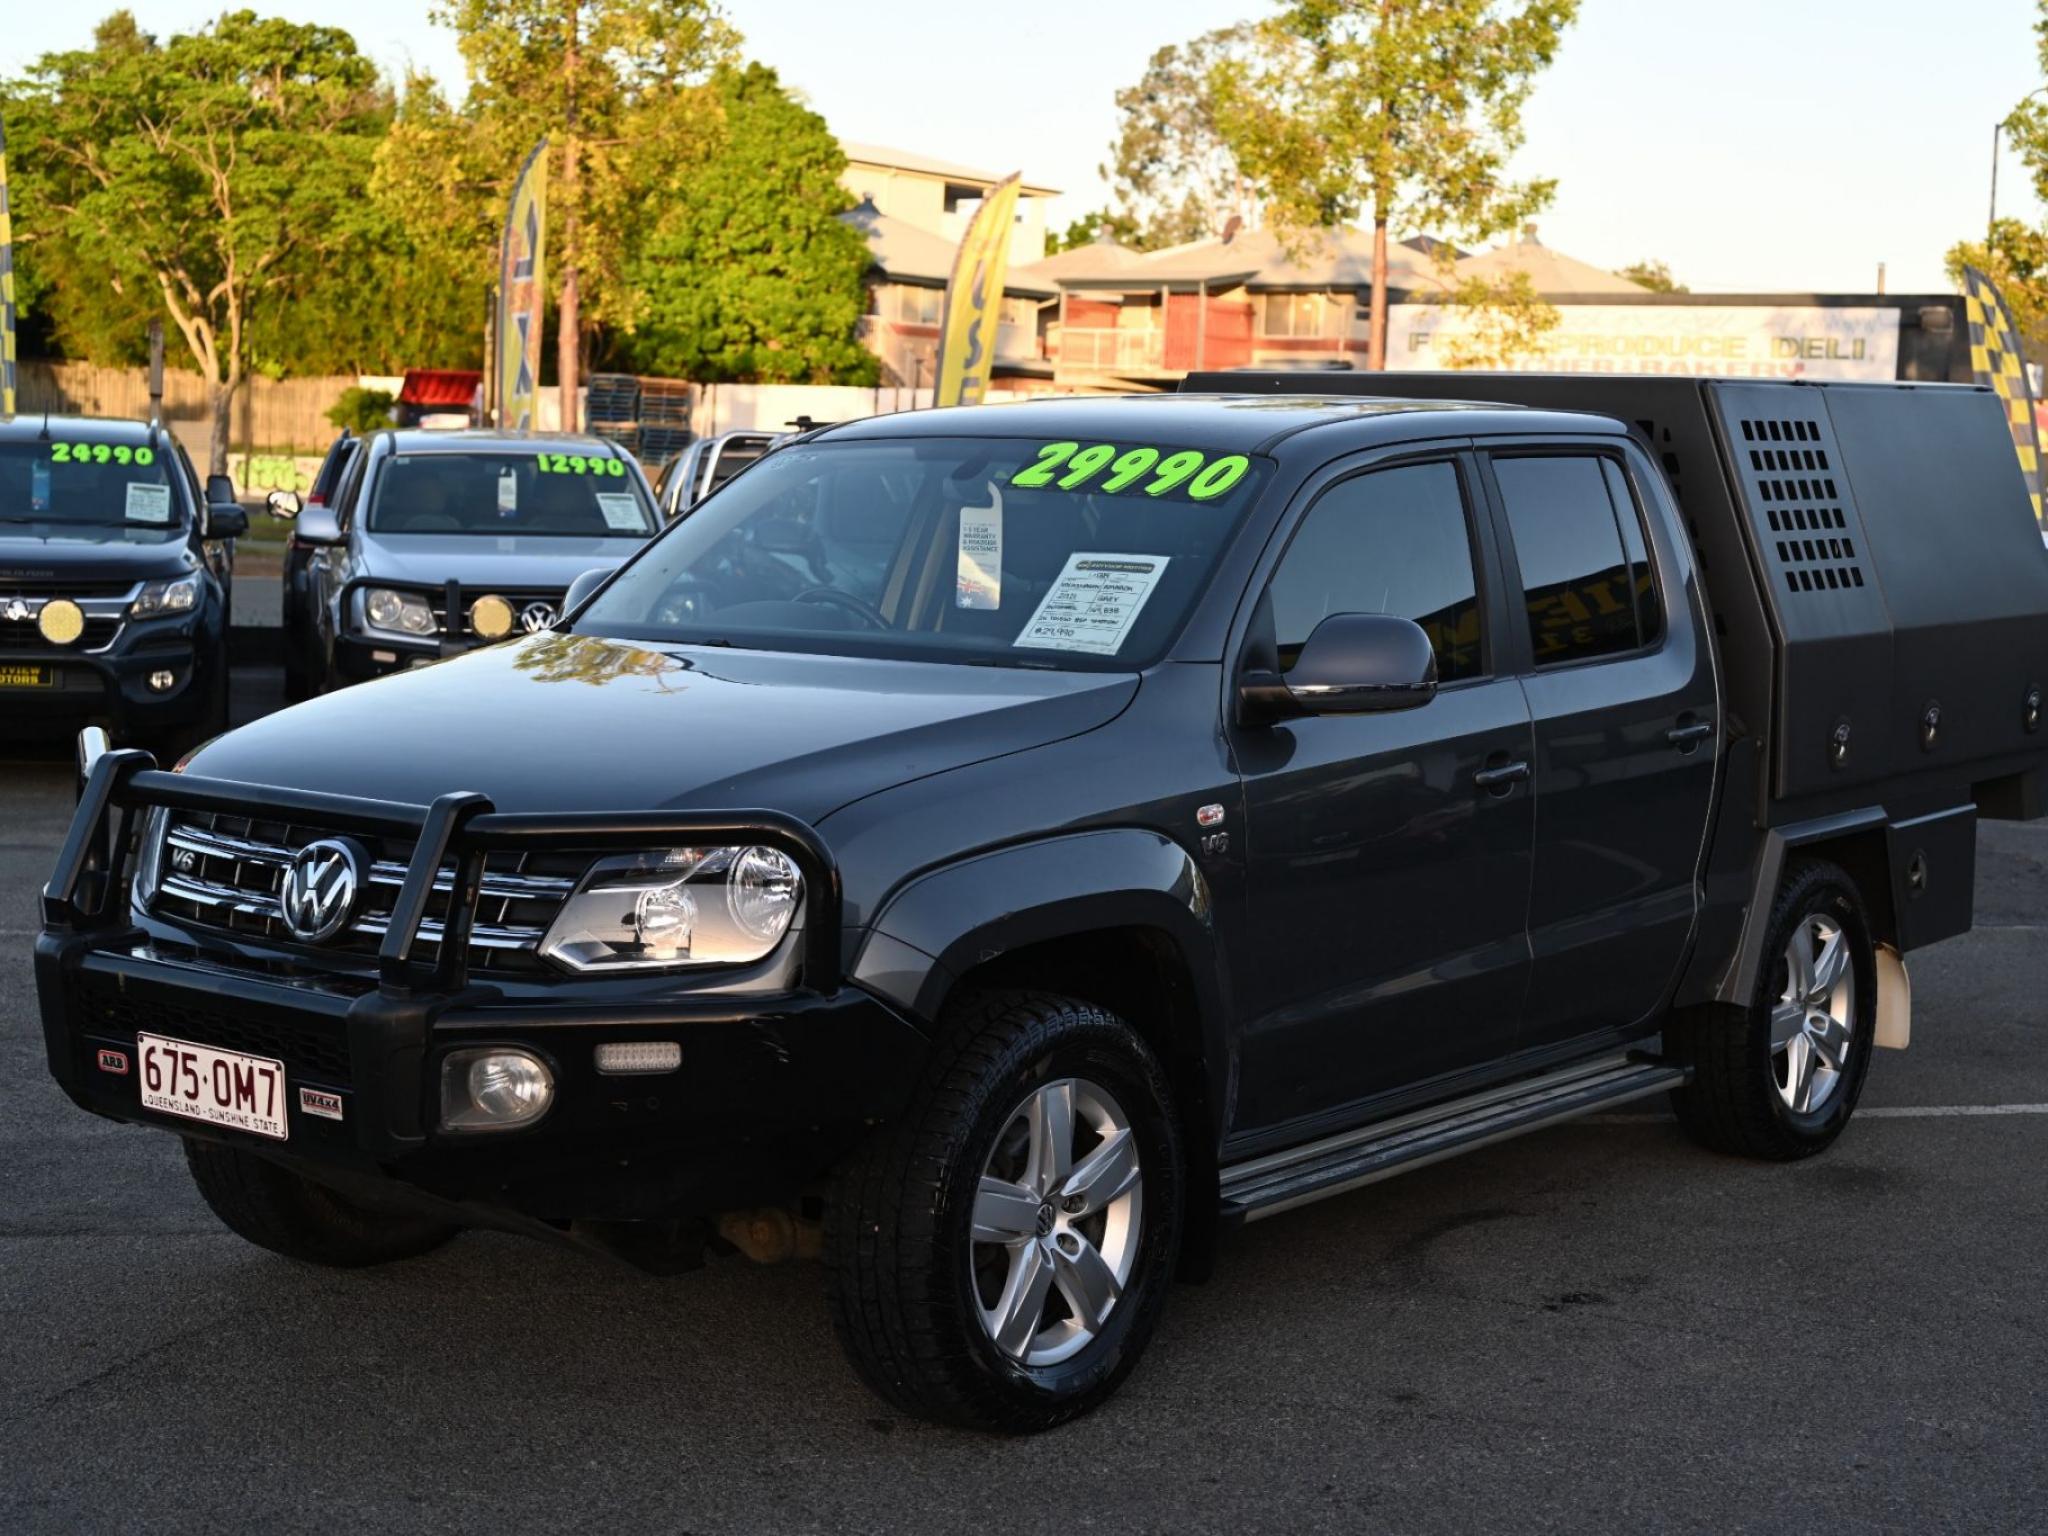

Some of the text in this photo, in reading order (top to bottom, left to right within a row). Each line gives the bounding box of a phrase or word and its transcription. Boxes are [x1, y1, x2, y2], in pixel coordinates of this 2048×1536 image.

[1771, 336, 1866, 360] DELI
[51, 442, 154, 465] 24990
[538, 453, 625, 477] 12990
[1011, 441, 1249, 501] 29990
[172, 847, 196, 872] V6
[101, 1054, 125, 1071] ARB
[147, 1093, 280, 1134] QUEENSLAND SUNSHINE STATE
